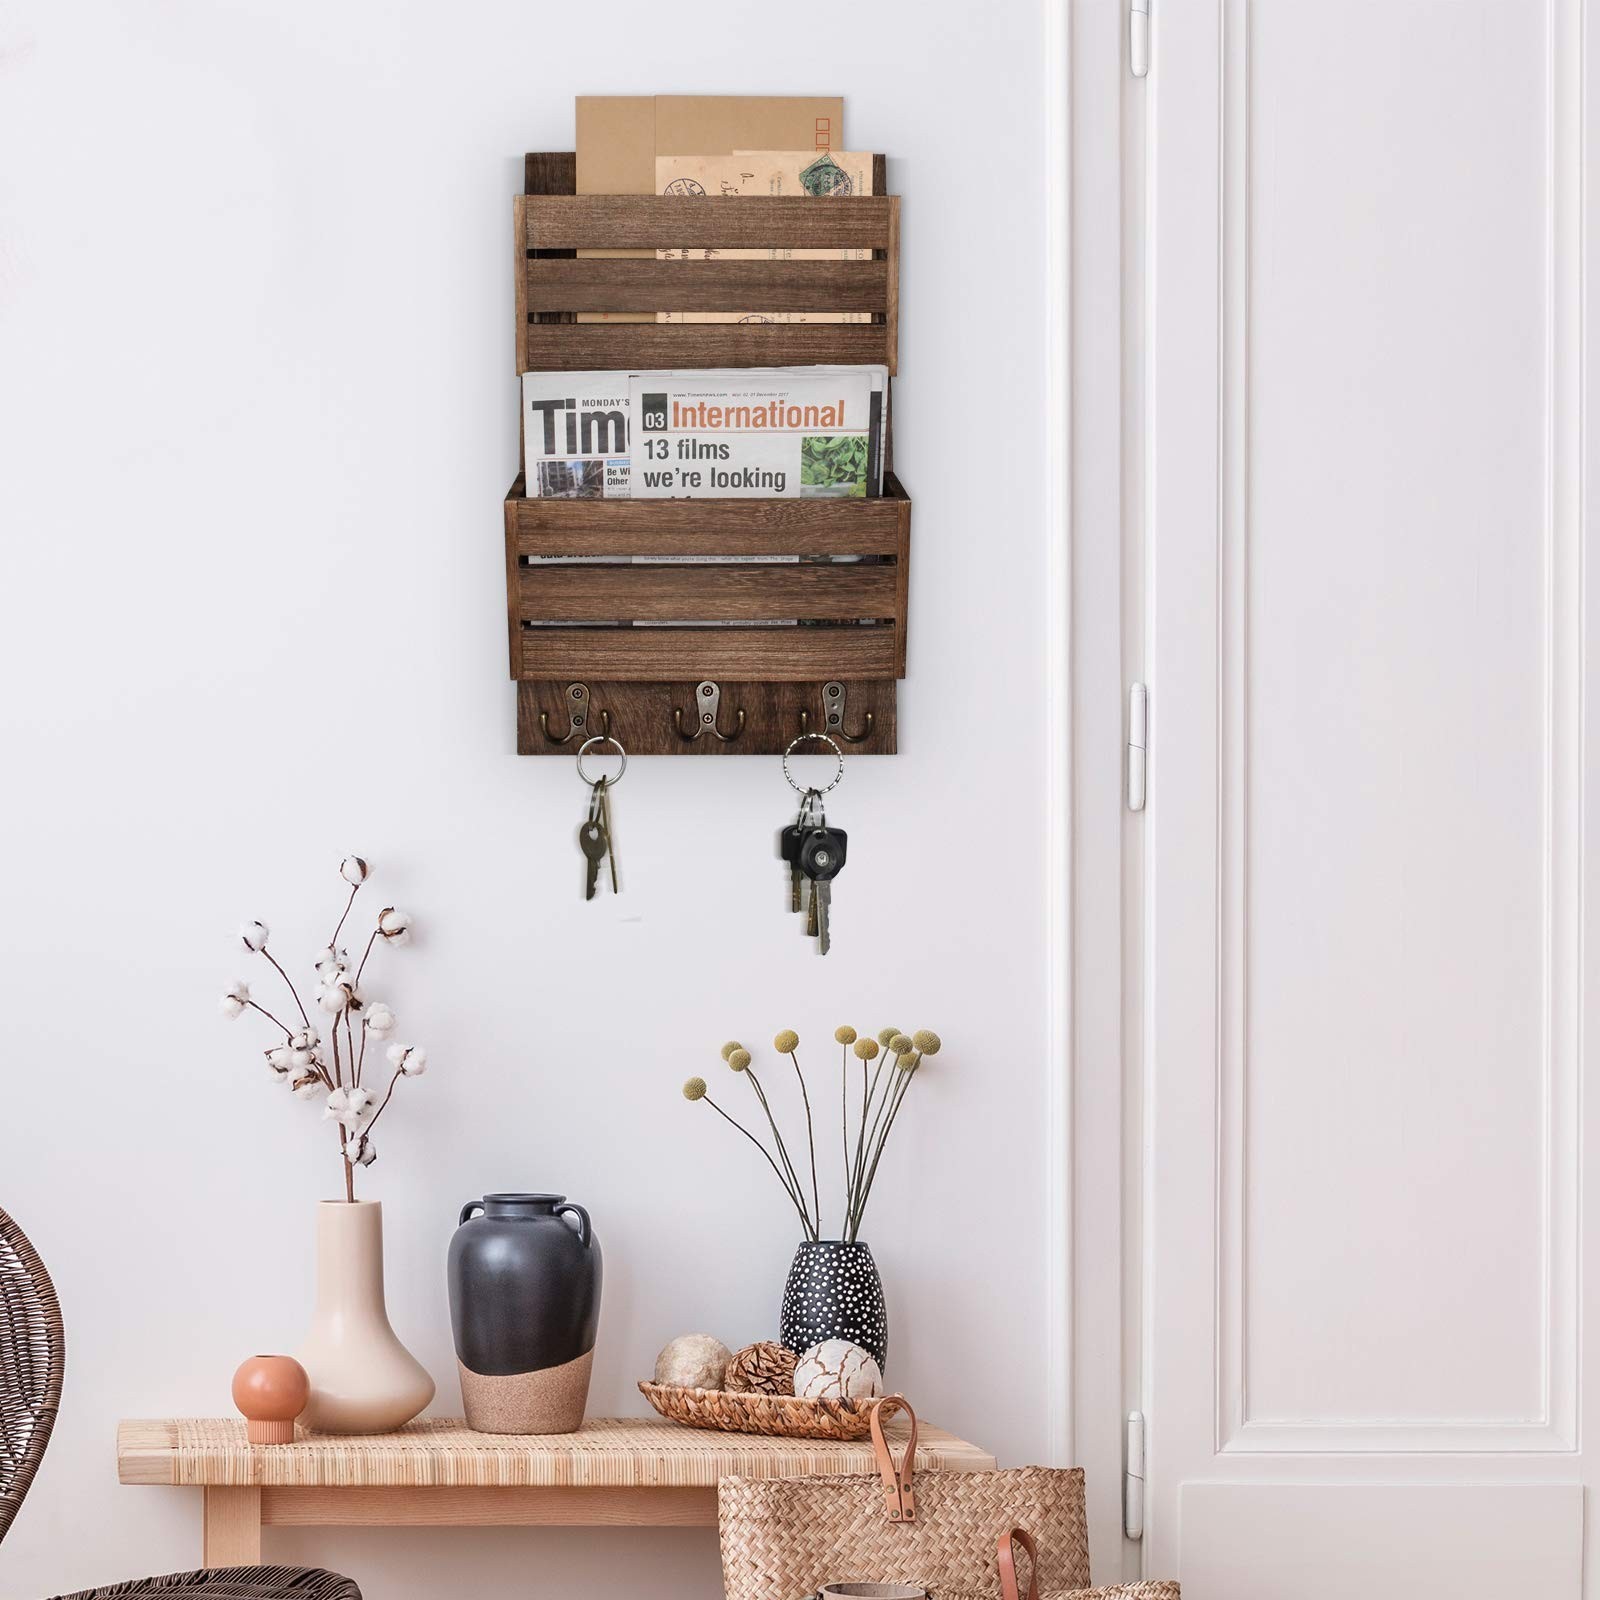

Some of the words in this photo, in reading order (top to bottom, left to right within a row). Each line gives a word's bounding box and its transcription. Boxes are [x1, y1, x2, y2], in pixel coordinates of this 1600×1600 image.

[582, 399, 630, 407] MONDAY'S
[645, 412, 665, 428] 03
[673, 400, 845, 428] International
[532, 398, 630, 454] Tim
[644, 438, 670, 460] 13
[677, 438, 730, 460] films
[607, 468, 617, 476] Be
[608, 478, 628, 486] Other
[644, 468, 702, 488] we're
[710, 467, 786, 492] looking
